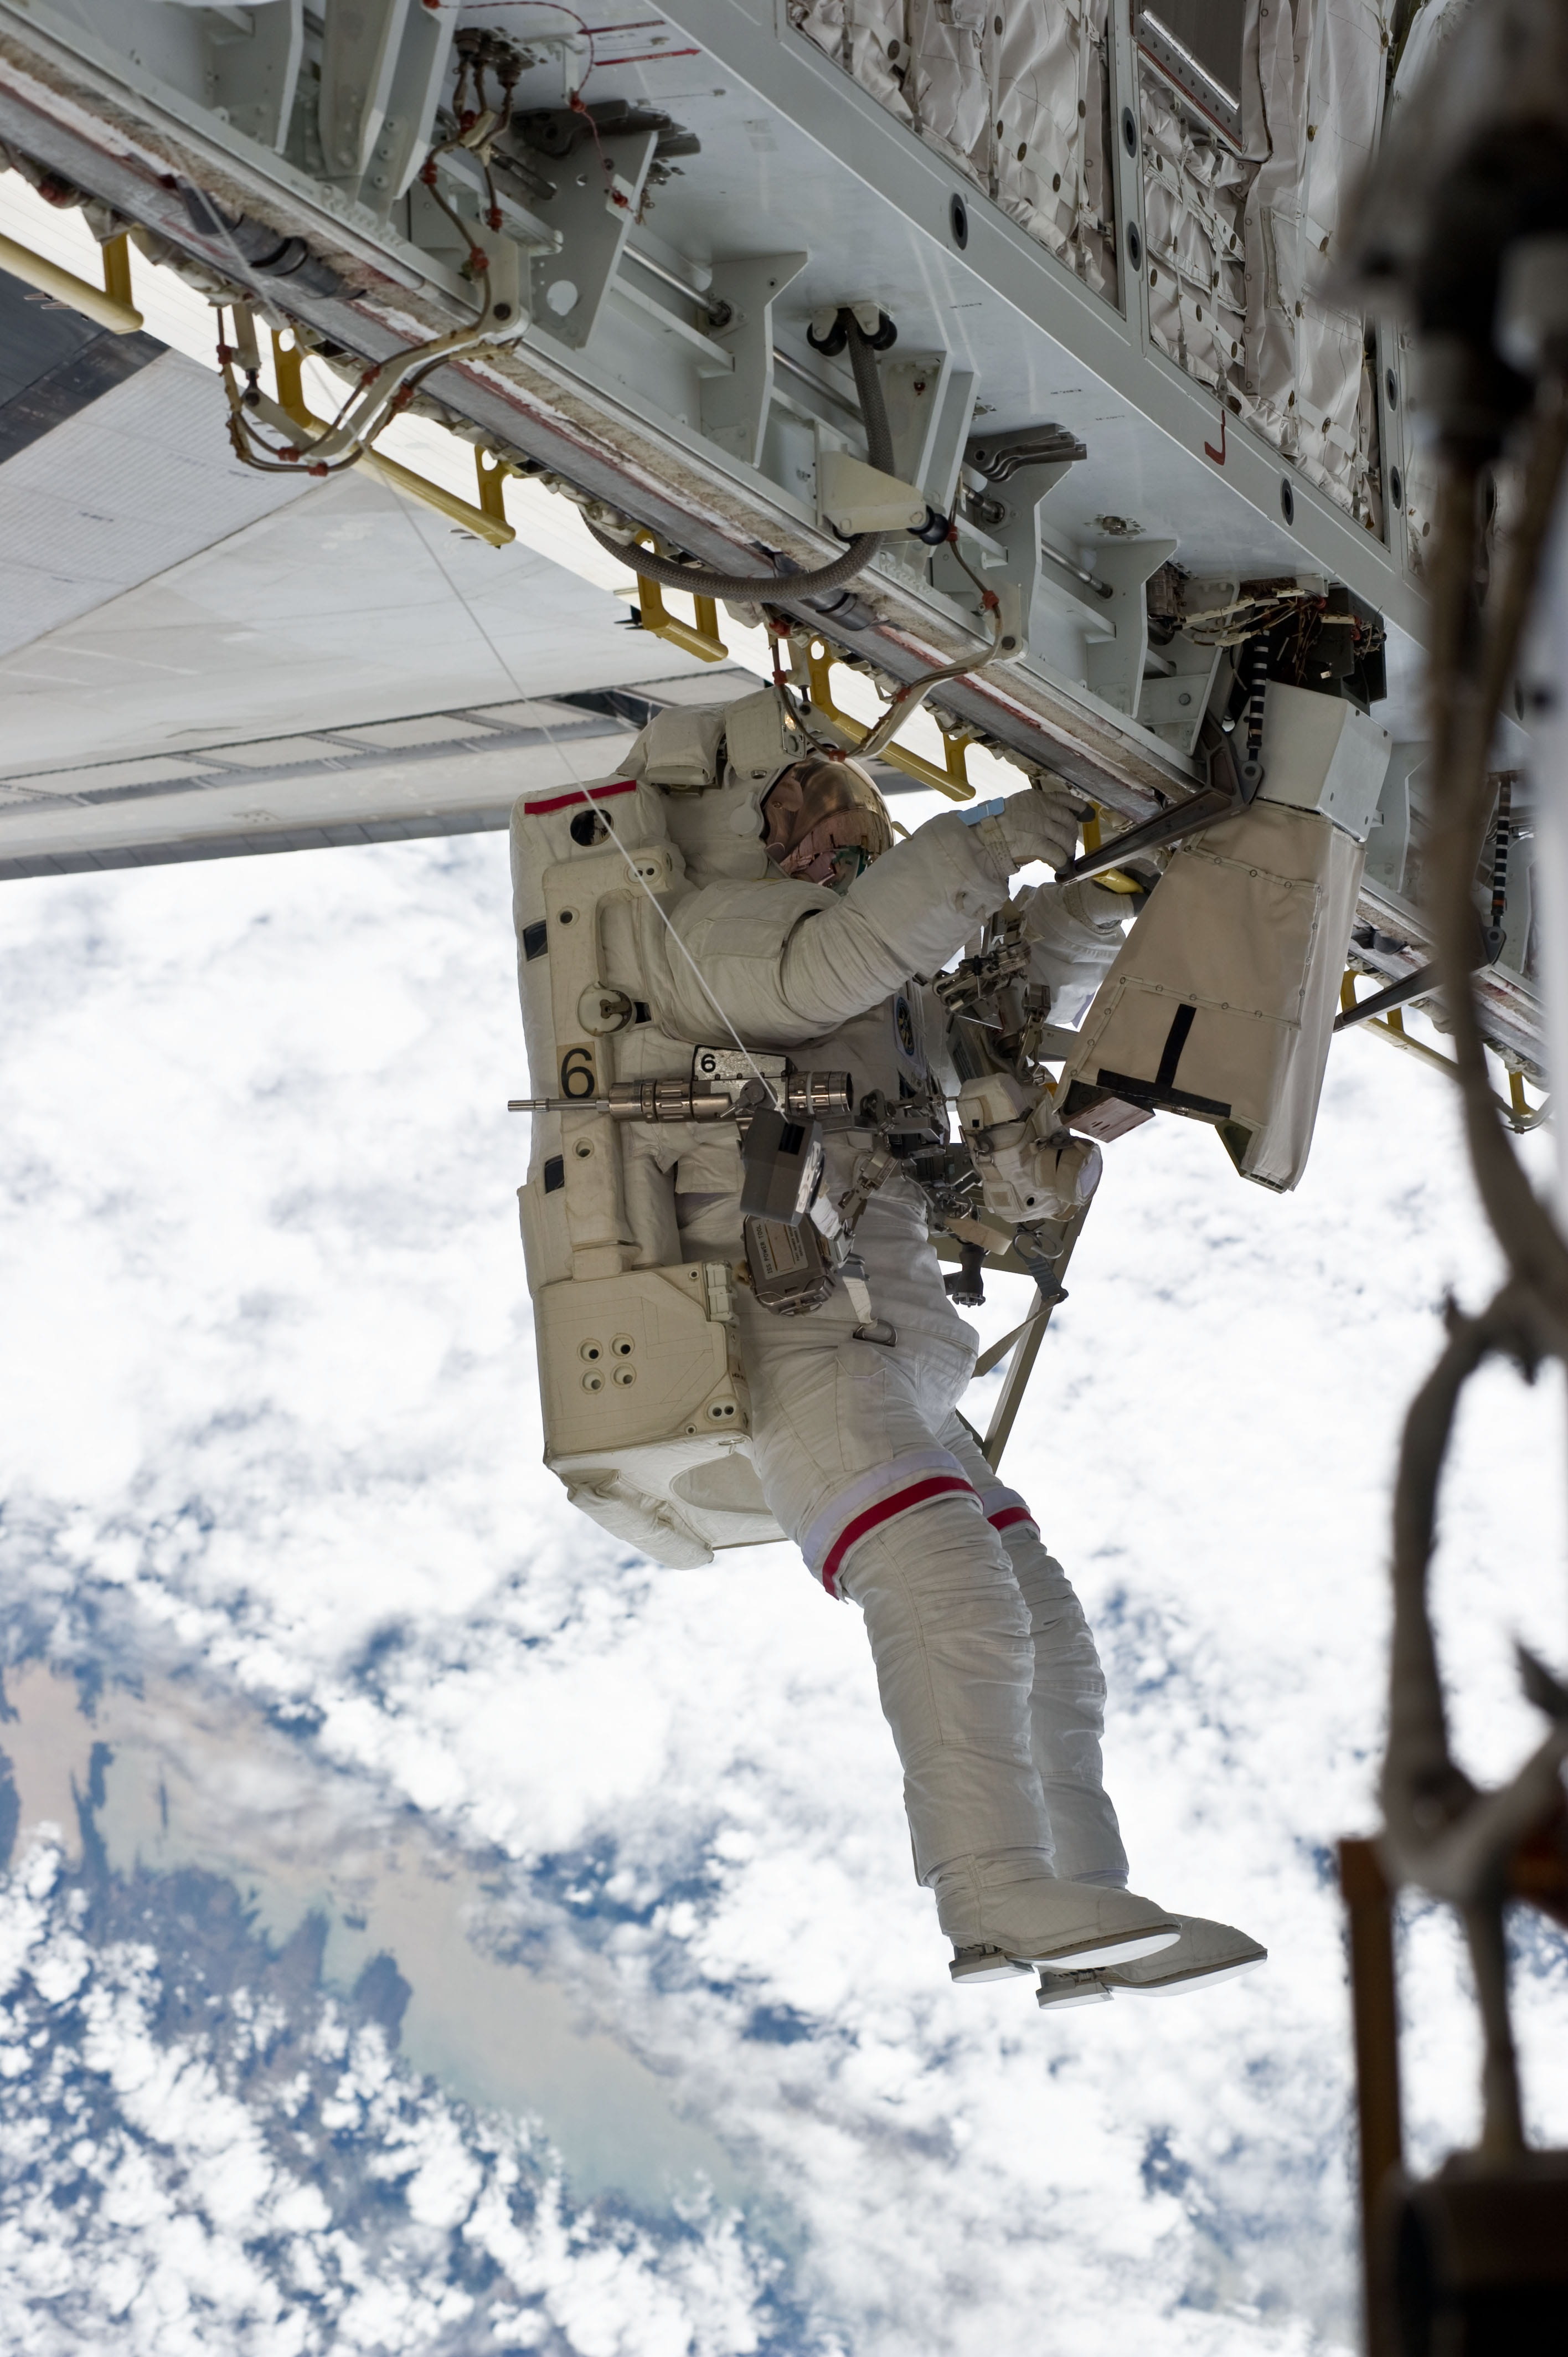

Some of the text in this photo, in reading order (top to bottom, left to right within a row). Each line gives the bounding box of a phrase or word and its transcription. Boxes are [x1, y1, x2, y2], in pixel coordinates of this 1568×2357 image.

[702, 1053, 716, 1073] 6
[561, 1048, 595, 1099] 6
[760, 1242, 770, 1262] POWER
